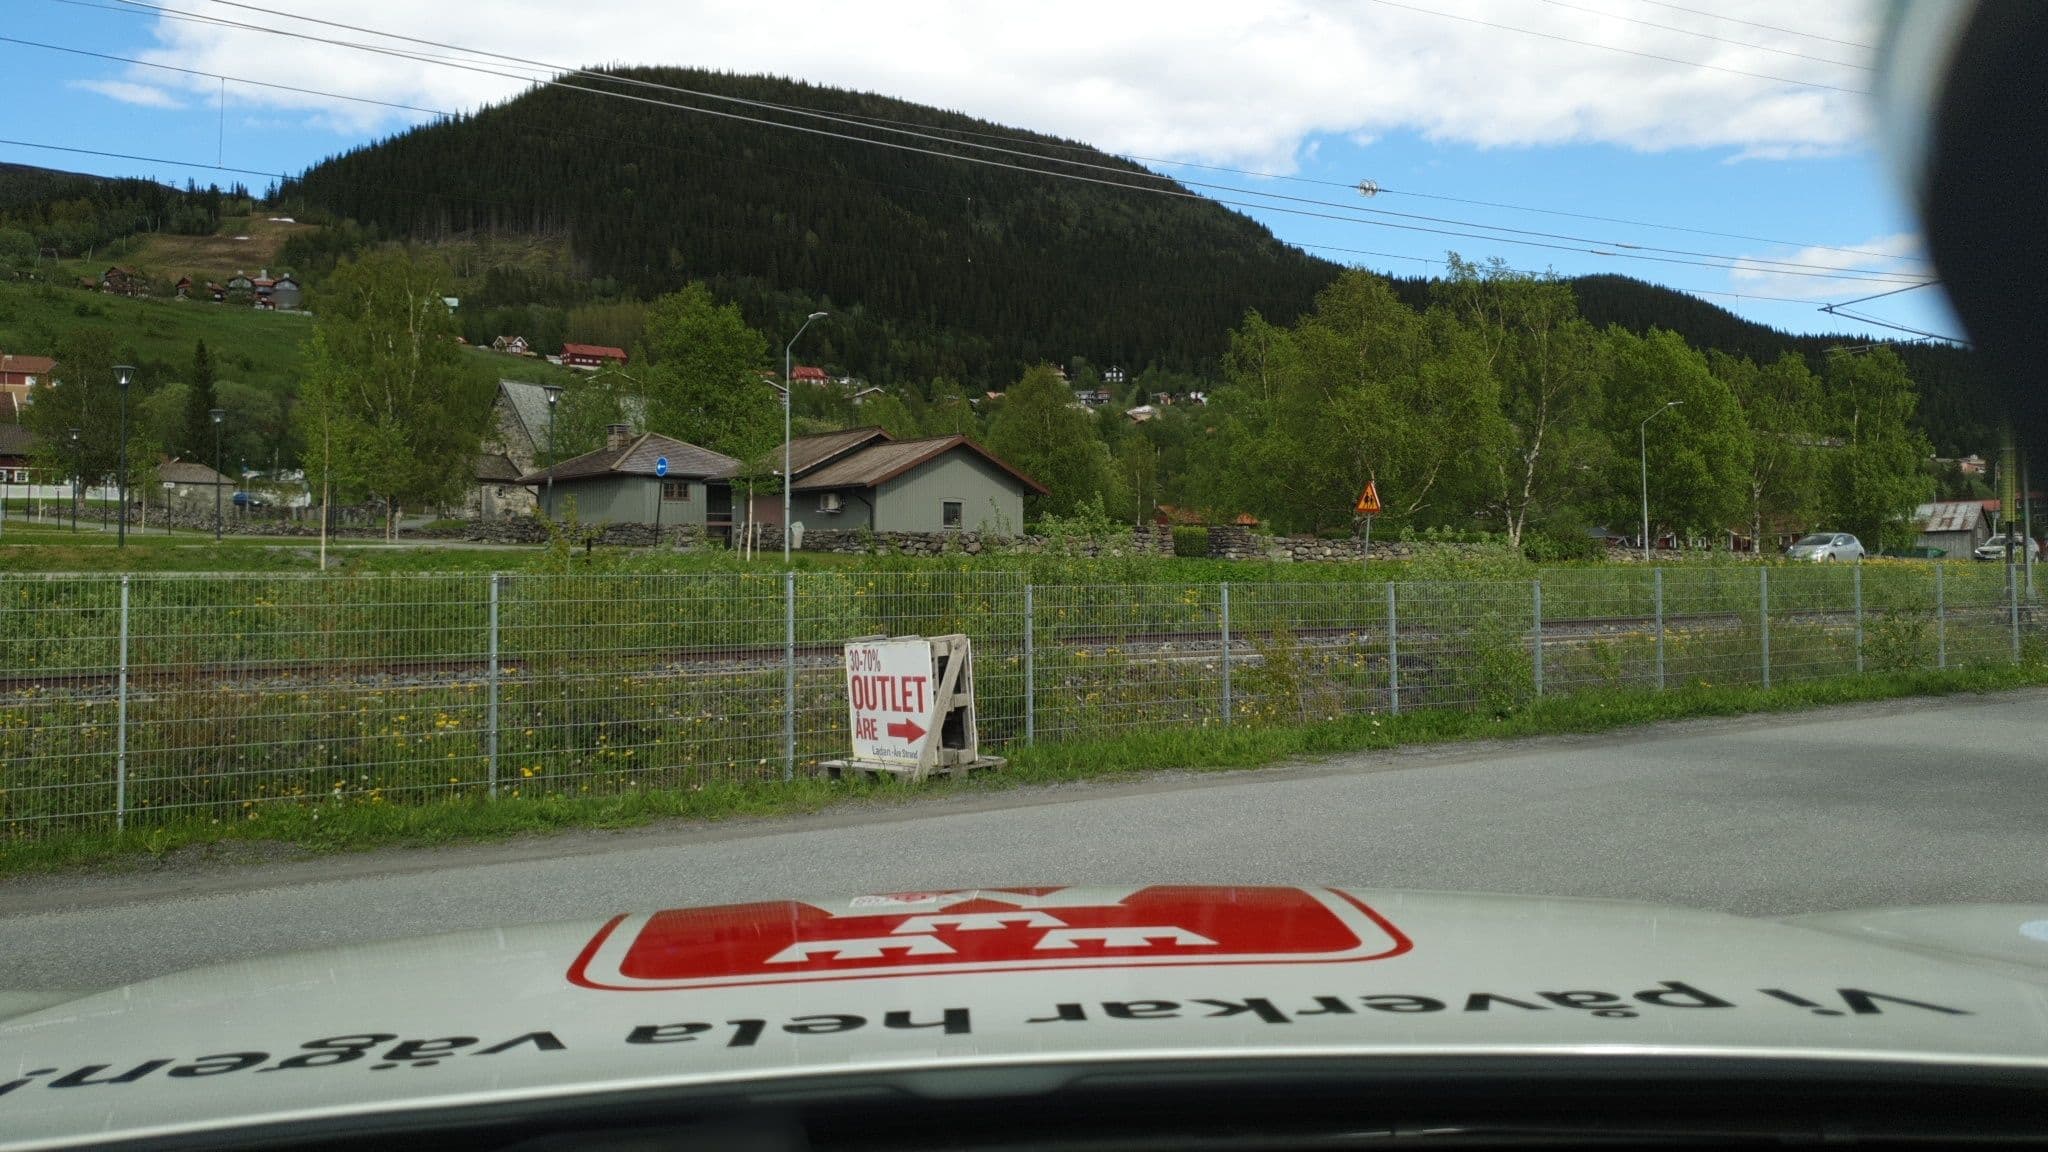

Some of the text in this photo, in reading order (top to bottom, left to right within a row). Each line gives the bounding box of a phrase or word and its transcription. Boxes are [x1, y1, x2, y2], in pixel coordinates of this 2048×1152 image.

[849, 648, 881, 672] 30-70%
[851, 675, 927, 713] OUTLET
[856, 711, 878, 741] ÅRE
[1026, 981, 1736, 1024] påverkar
[1756, 988, 1976, 1016] Vi
[625, 1008, 971, 1047] hela
